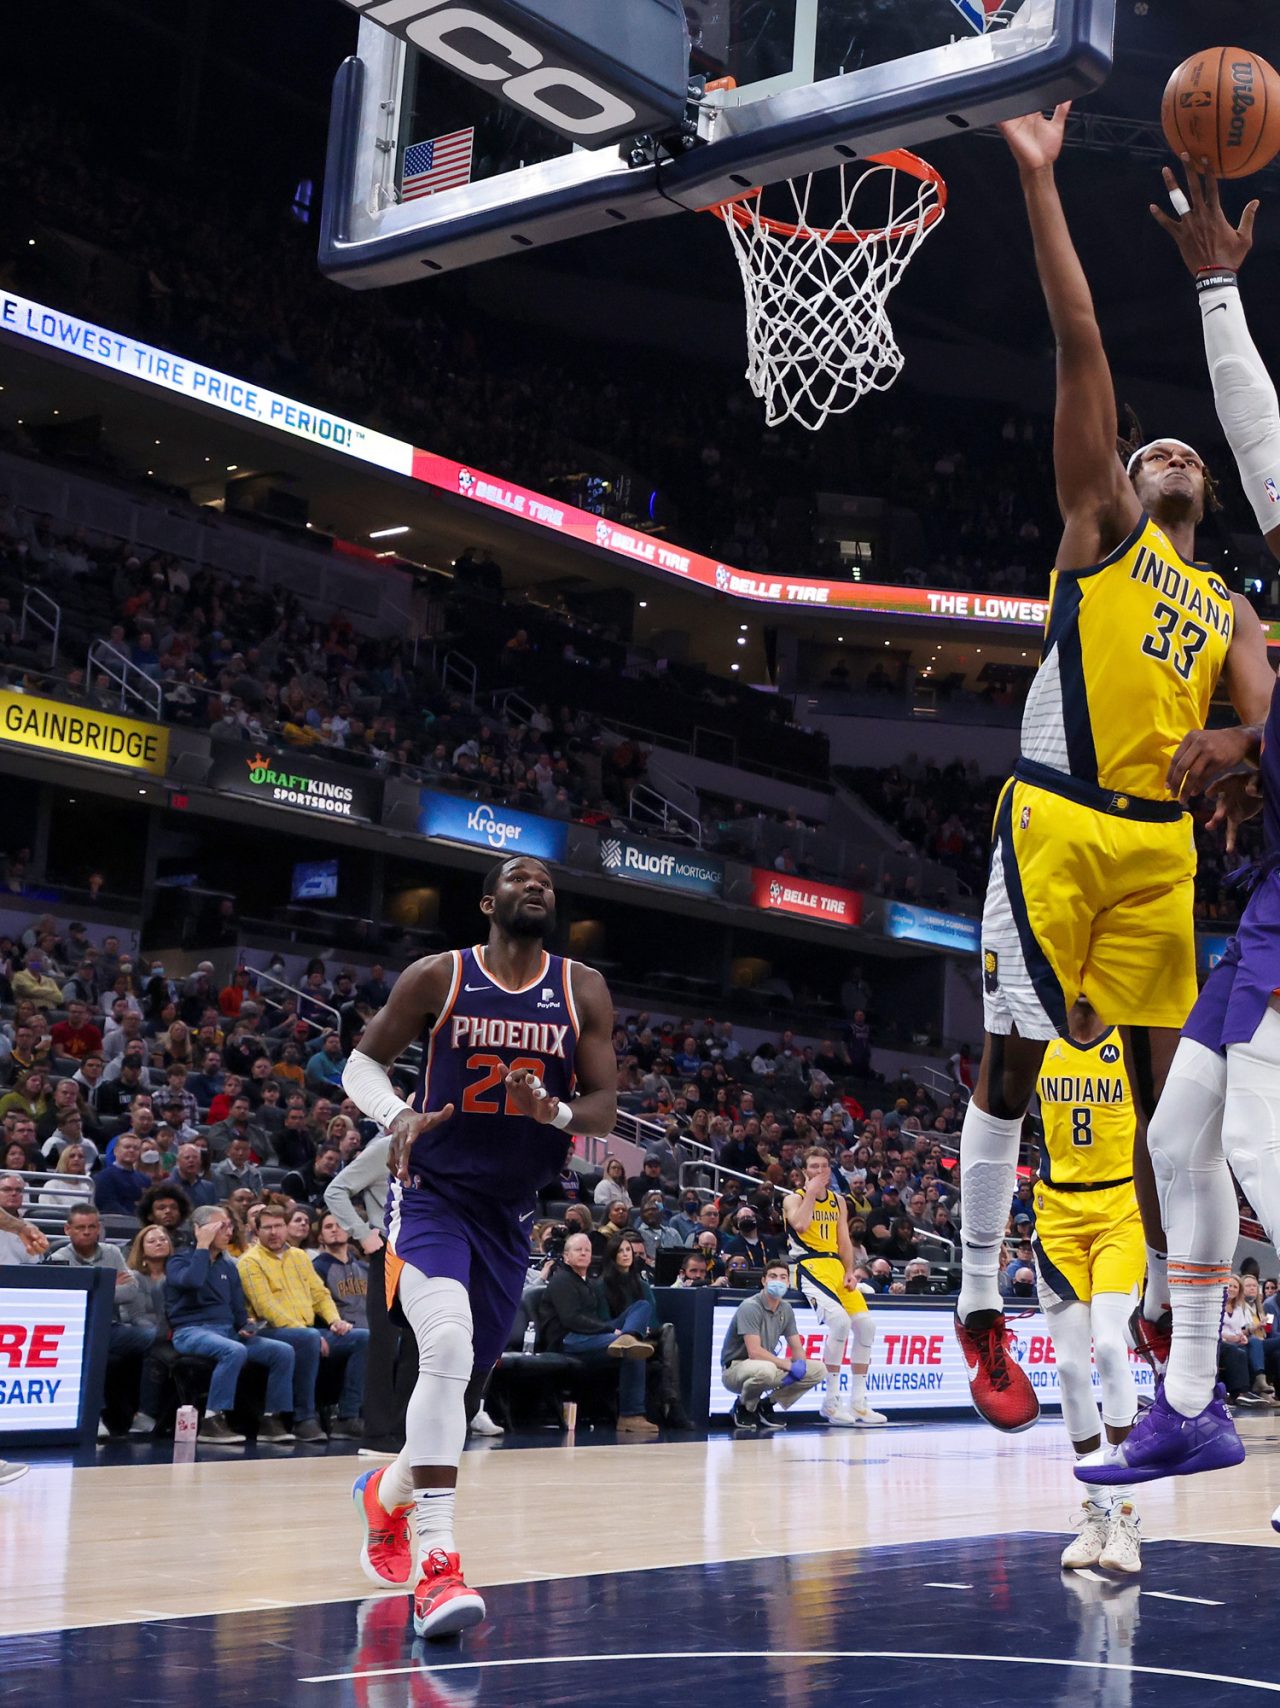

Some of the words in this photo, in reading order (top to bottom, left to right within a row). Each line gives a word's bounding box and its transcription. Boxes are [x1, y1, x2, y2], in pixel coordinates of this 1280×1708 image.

[346, 0, 636, 134] ICO
[1226, 62, 1254, 147] Wilson
[27, 308, 128, 362] LOWEST
[134, 349, 184, 386] TIRE
[193, 371, 263, 417] PRICE,
[475, 481, 525, 510] BELLE
[528, 499, 564, 527] TIRE
[610, 531, 655, 560] BELLE
[658, 549, 690, 574] TIRE
[729, 576, 780, 599] BELLE
[786, 585, 830, 603] TIRE
[927, 594, 968, 616] THE
[1130, 546, 1230, 644] INDIANA
[1141, 601, 1208, 680] 33
[5, 703, 158, 762] GAINBRIDGE
[249, 766, 353, 801] DRAFTKINGS
[273, 787, 352, 815] SPORTSBOOK
[467, 804, 522, 847] Kroger
[625, 846, 675, 876] Ruoff
[675, 865, 722, 882] MORTGAGE
[783, 888, 817, 908] BELLE
[820, 897, 846, 915] TIRE
[536, 1001, 561, 1009] PayPal
[450, 1015, 569, 1059] PHOENIX
[1040, 1077, 1123, 1104] INDIANA
[1072, 1107, 1093, 1147] 8
[820, 1223, 829, 1240] 11
[883, 1335, 944, 1365] TIRE
[866, 1372, 944, 1391] NNIVERSARY
